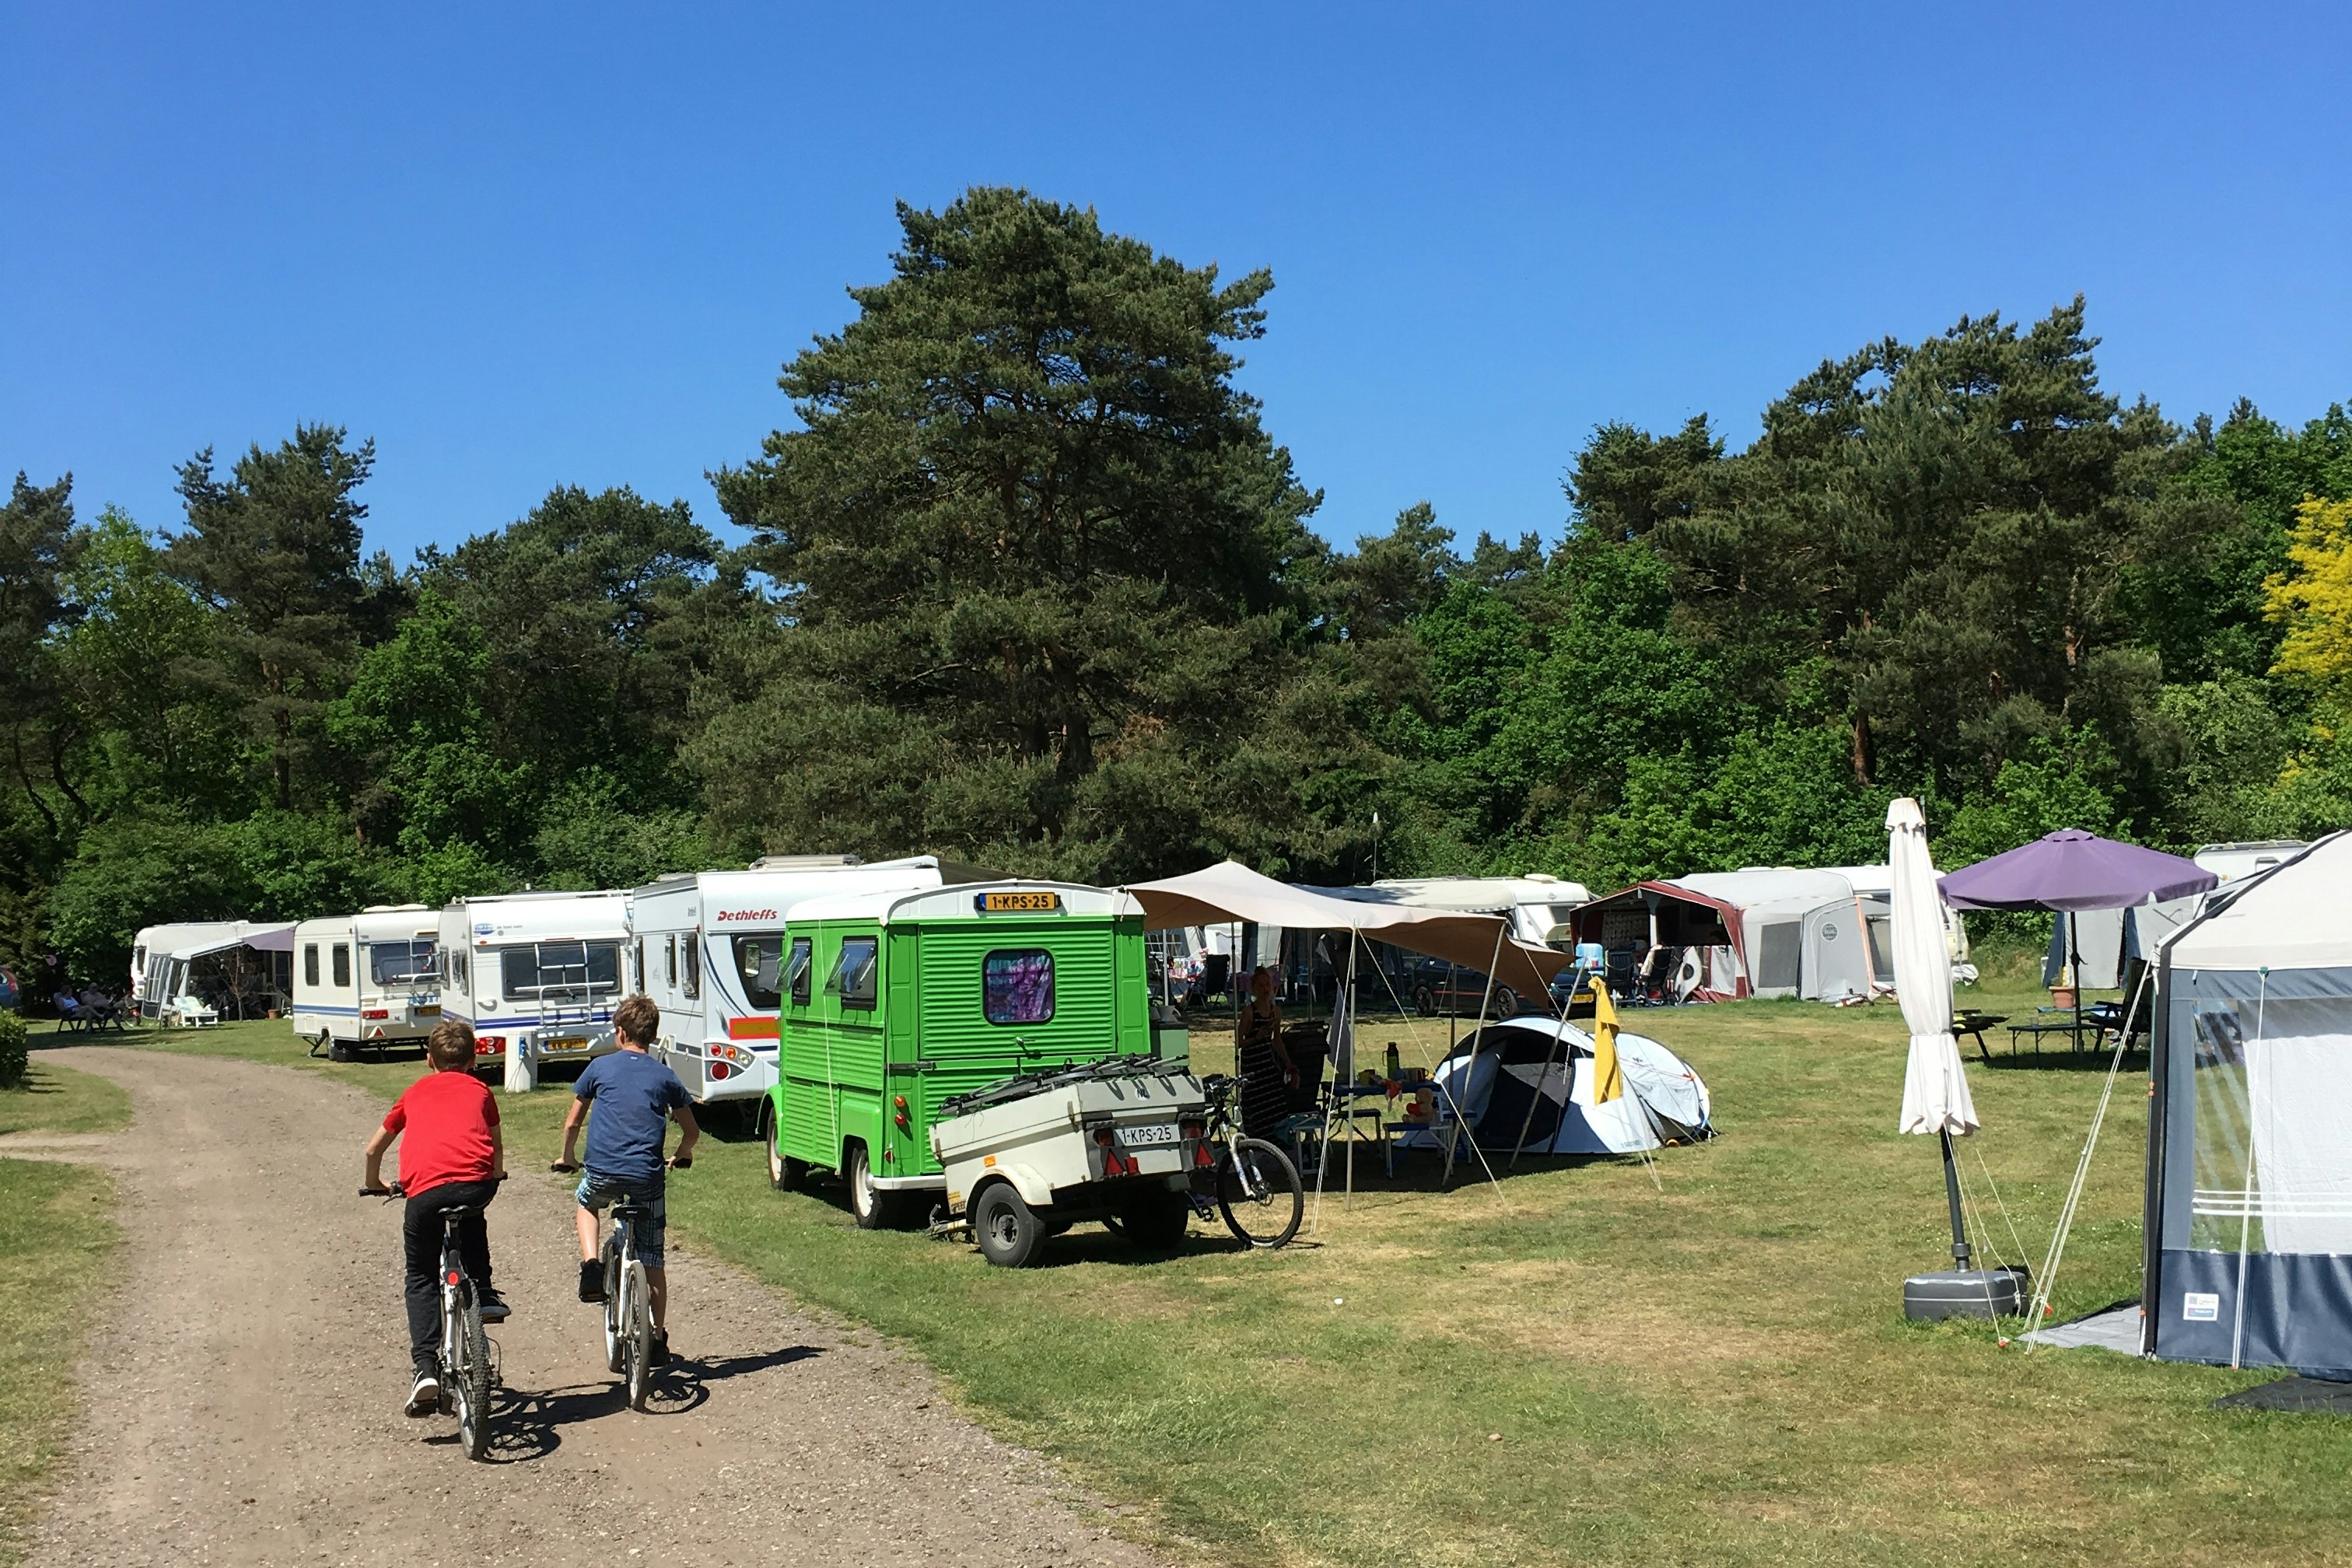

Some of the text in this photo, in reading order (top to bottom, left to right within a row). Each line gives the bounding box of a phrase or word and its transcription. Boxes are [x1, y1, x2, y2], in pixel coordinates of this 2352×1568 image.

[992, 895, 1049, 909] 1-KPS-25
[717, 908, 778, 922] Dethleffs
[1122, 1127, 1172, 1144] 1-KPS-25
